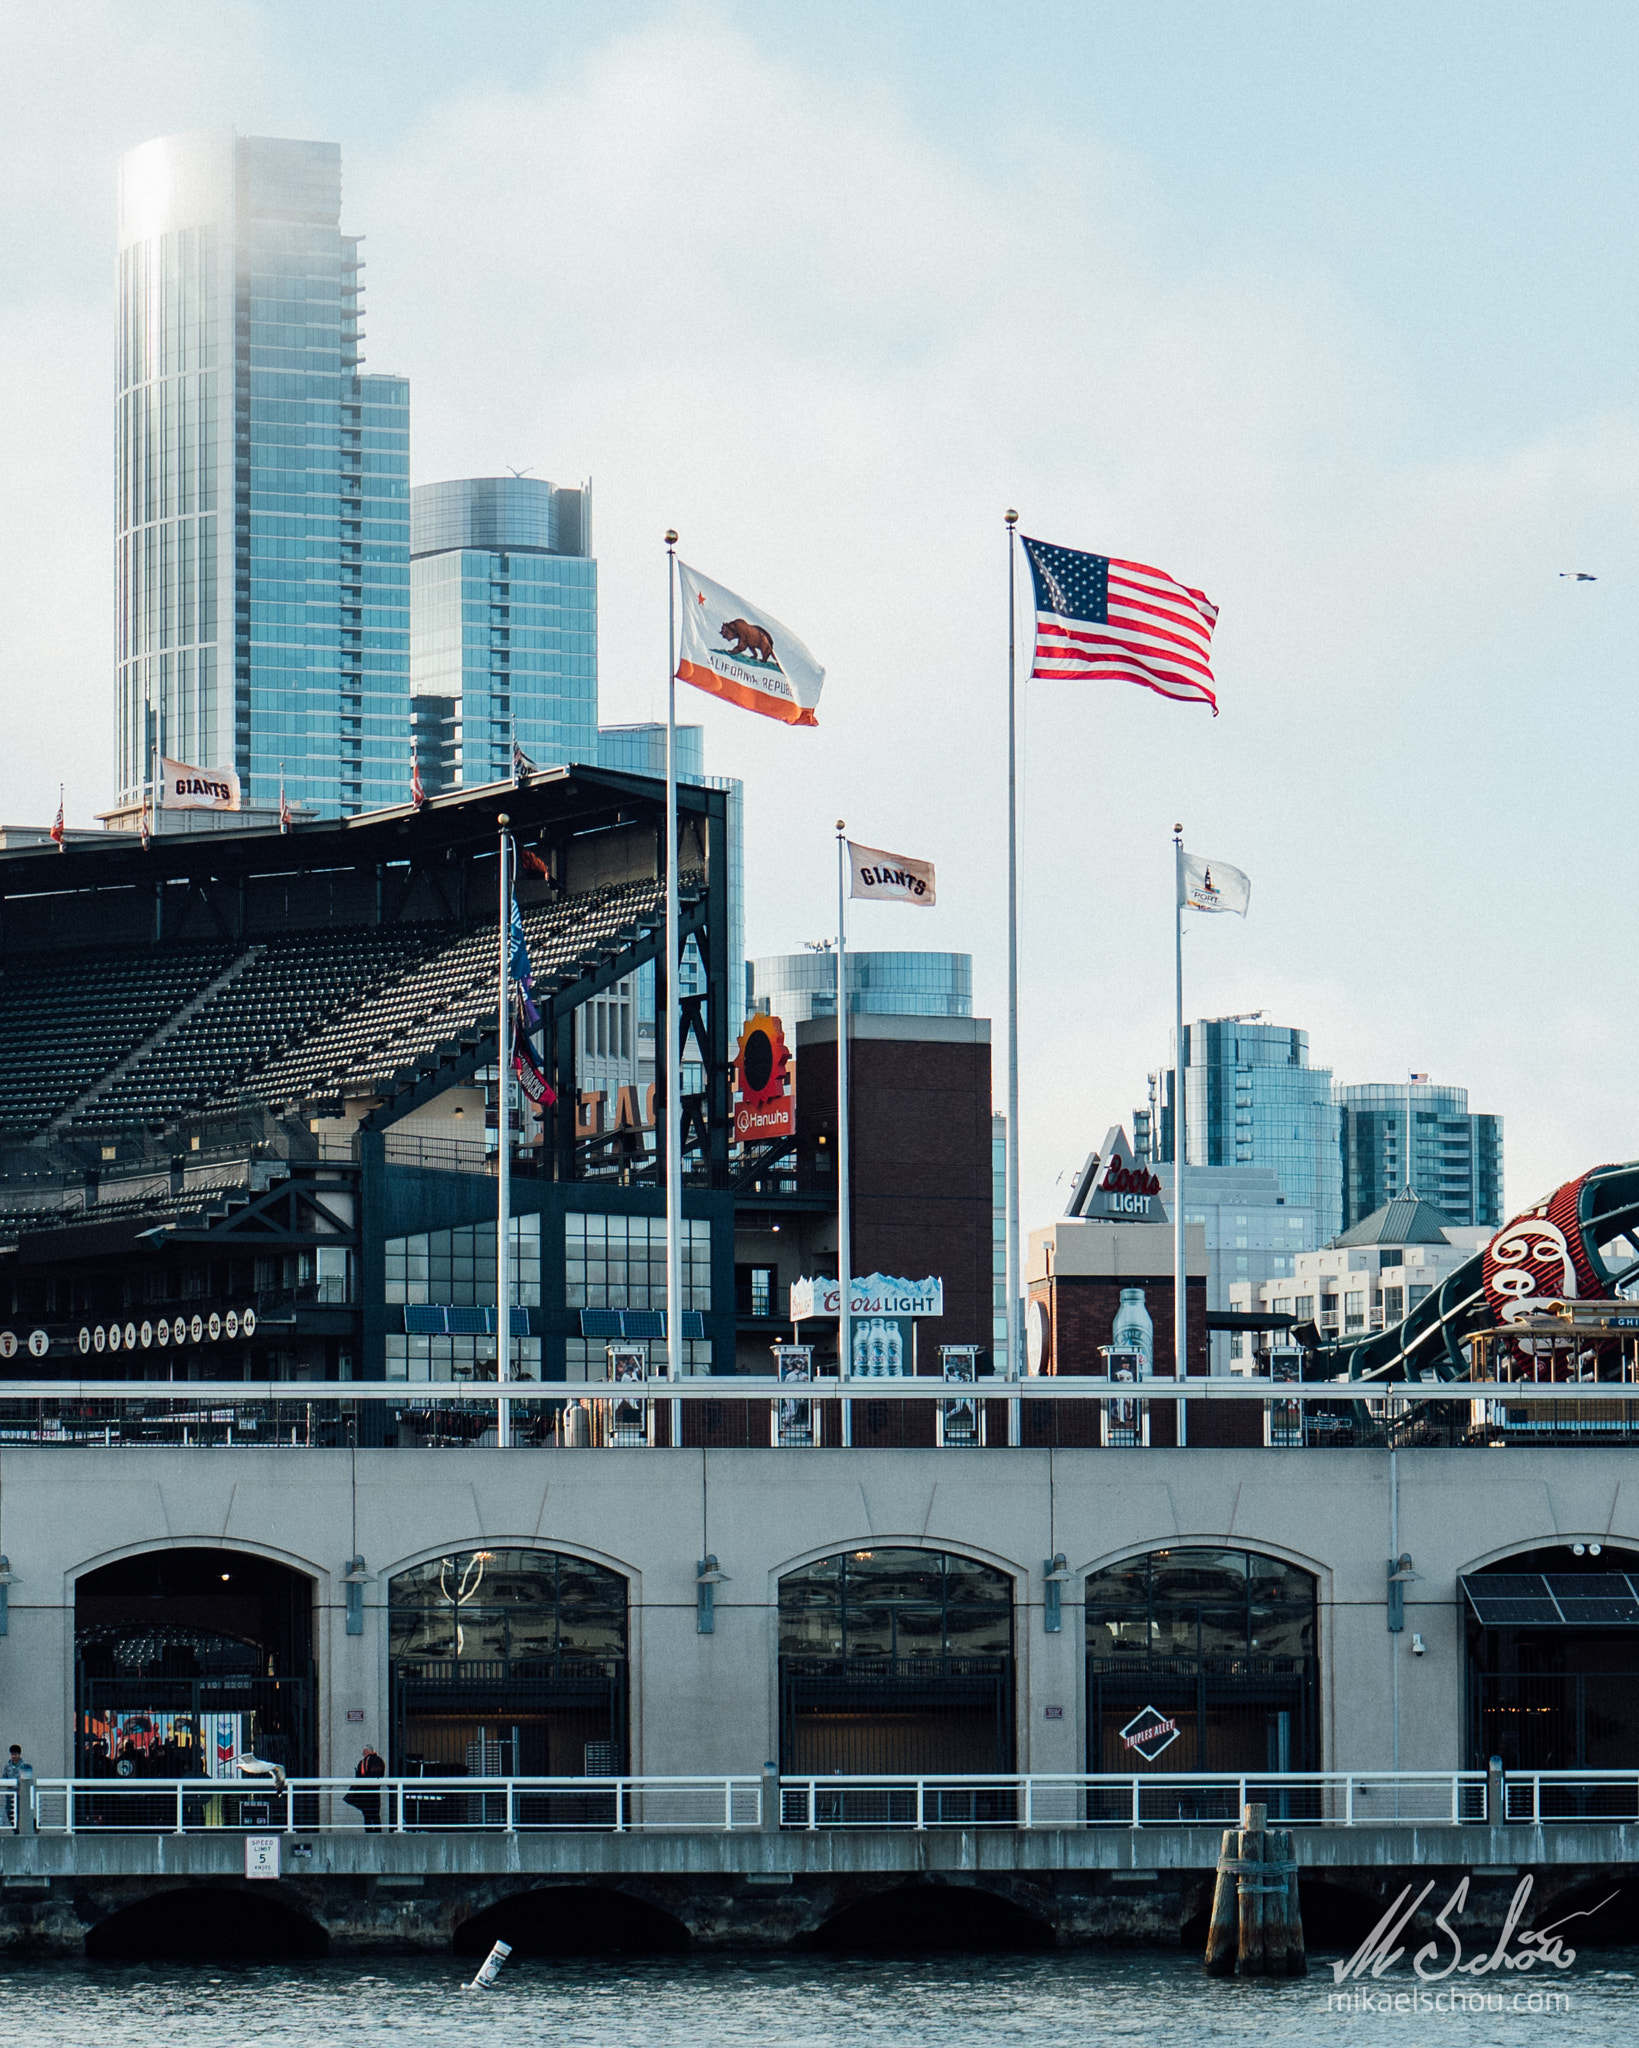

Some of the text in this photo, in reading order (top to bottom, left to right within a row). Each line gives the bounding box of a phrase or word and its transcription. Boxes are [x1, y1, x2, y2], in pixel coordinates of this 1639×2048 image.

[175, 779, 231, 800] GIANTS
[860, 866, 927, 896] GIANTS
[1193, 891, 1219, 903] PORT
[749, 1110, 789, 1128] Hanwha
[1101, 1154, 1162, 1196] Coors
[1113, 1193, 1151, 1214] LIGHT
[823, 1290, 882, 1312] Cors
[884, 1297, 935, 1312] LIGHT
[210, 1320, 219, 1333] 30
[244, 1315, 254, 1328] 44
[143, 1328, 149, 1340] 11
[176, 1324, 184, 1337] 24
[193, 1322, 201, 1335] 27
[112, 1331, 117, 1344] 3
[127, 1330, 132, 1341] 4
[1126, 1719, 1174, 1748] TRIPLES ALLEY
[259, 1853, 266, 1863] 5
